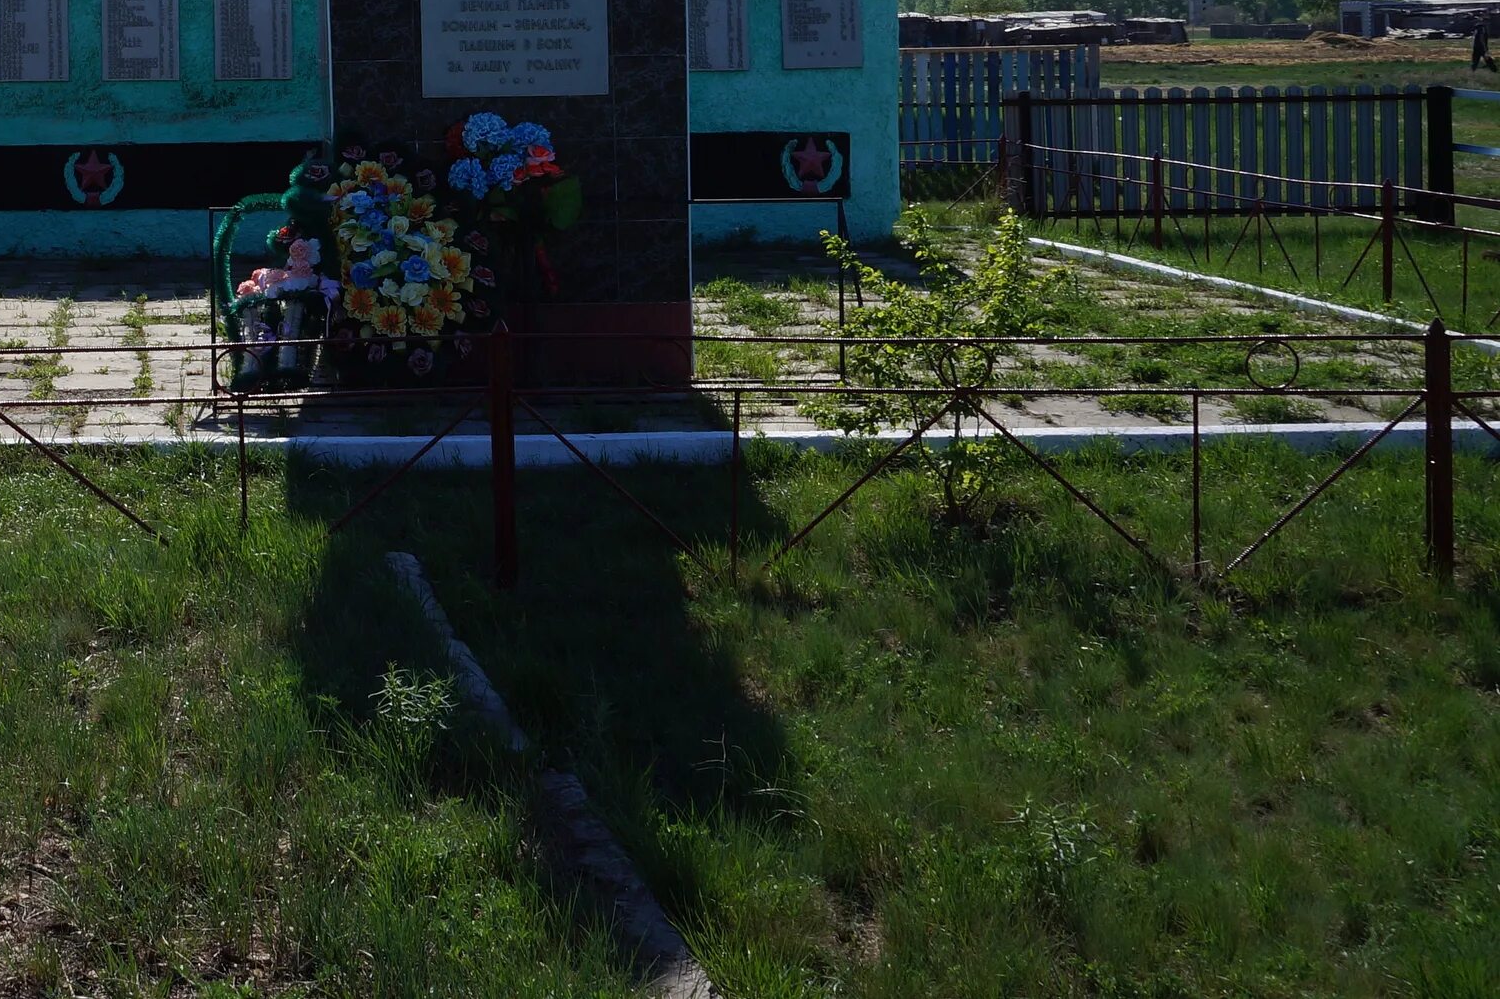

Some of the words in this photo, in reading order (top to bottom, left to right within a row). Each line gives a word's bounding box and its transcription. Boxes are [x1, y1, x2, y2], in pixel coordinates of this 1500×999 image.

[460, 0, 510, 12] ВЕЧНАЯ
[441, 20, 498, 32] ВОИНАМ
[459, 39, 516, 51] ПАВШИМ
[523, 38, 532, 50] В
[536, 37, 573, 50] БОЯХ
[447, 61, 464, 72] ЗА
[472, 60, 511, 72] НАШУ
[526, 58, 581, 72] РОДИНУ
